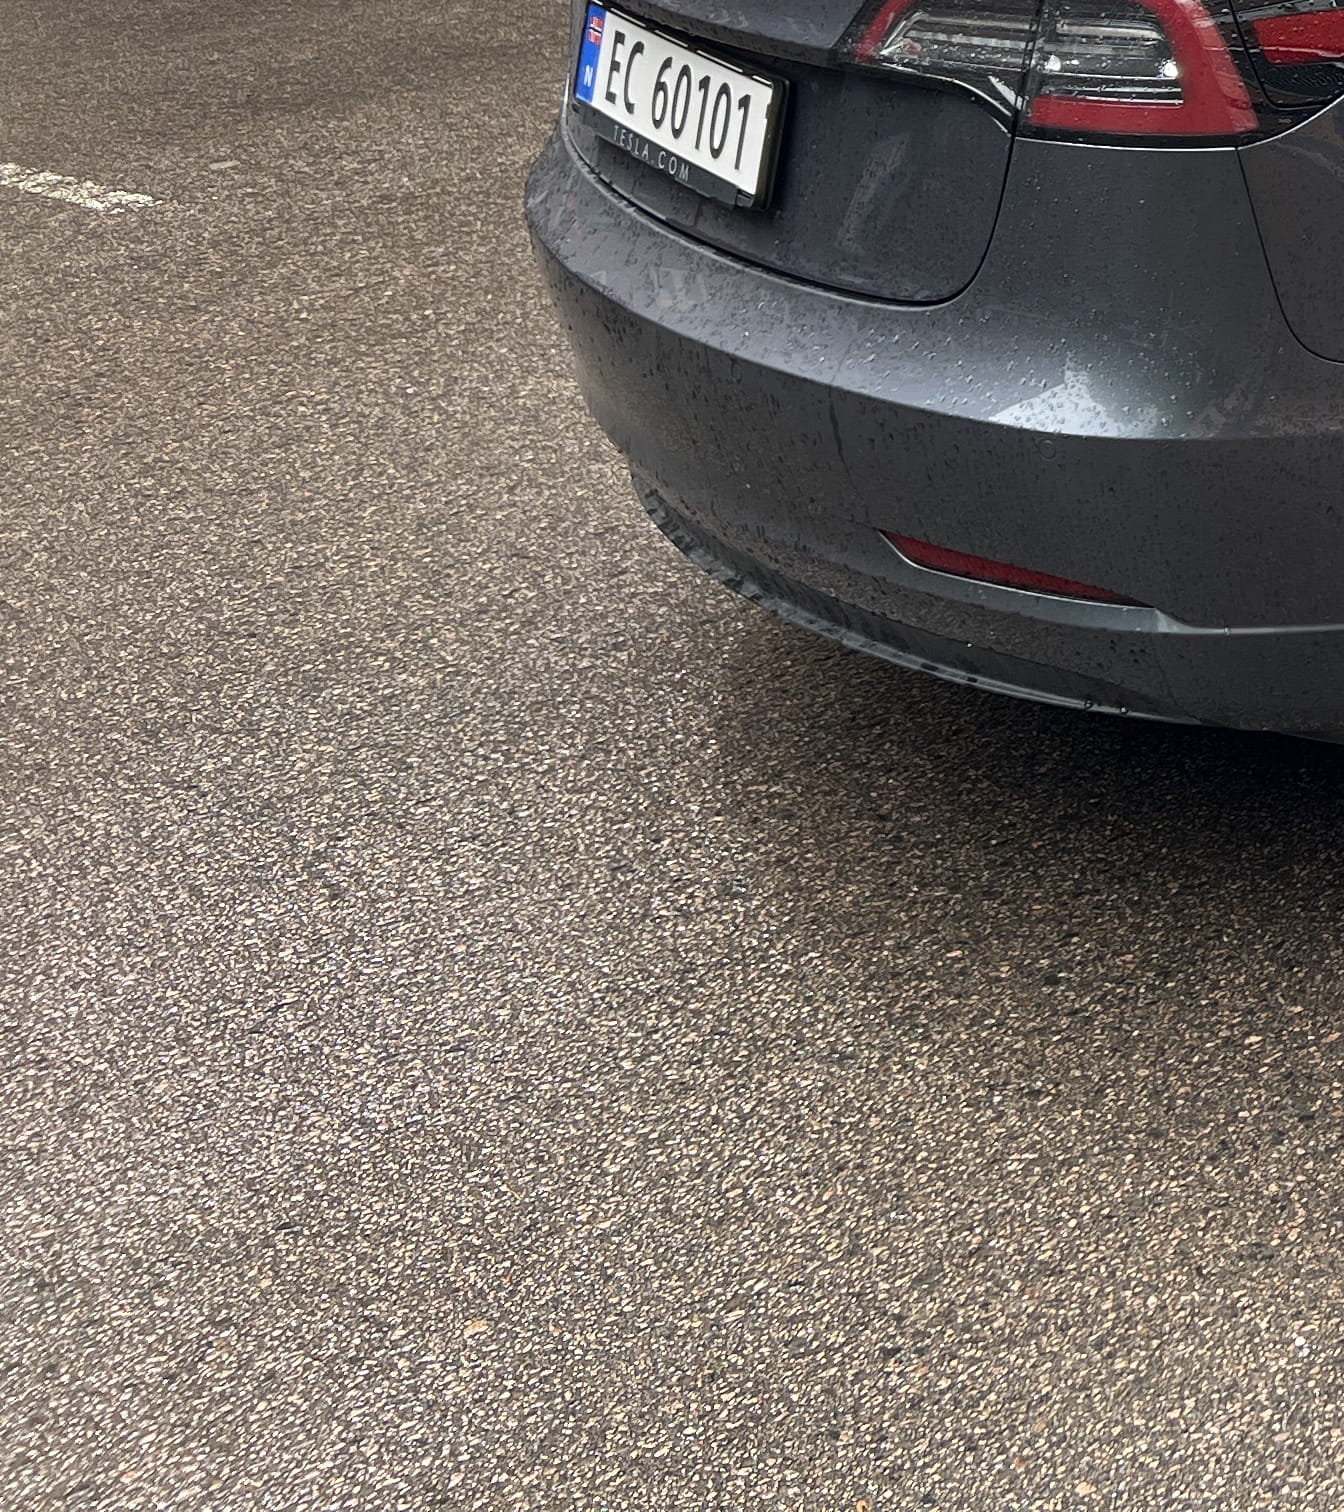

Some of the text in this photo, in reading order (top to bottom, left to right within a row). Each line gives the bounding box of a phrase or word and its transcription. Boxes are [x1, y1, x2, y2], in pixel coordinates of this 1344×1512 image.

[583, 64, 594, 88] N
[605, 30, 752, 170] EC 60101
[613, 124, 690, 182] TESLA.COM
